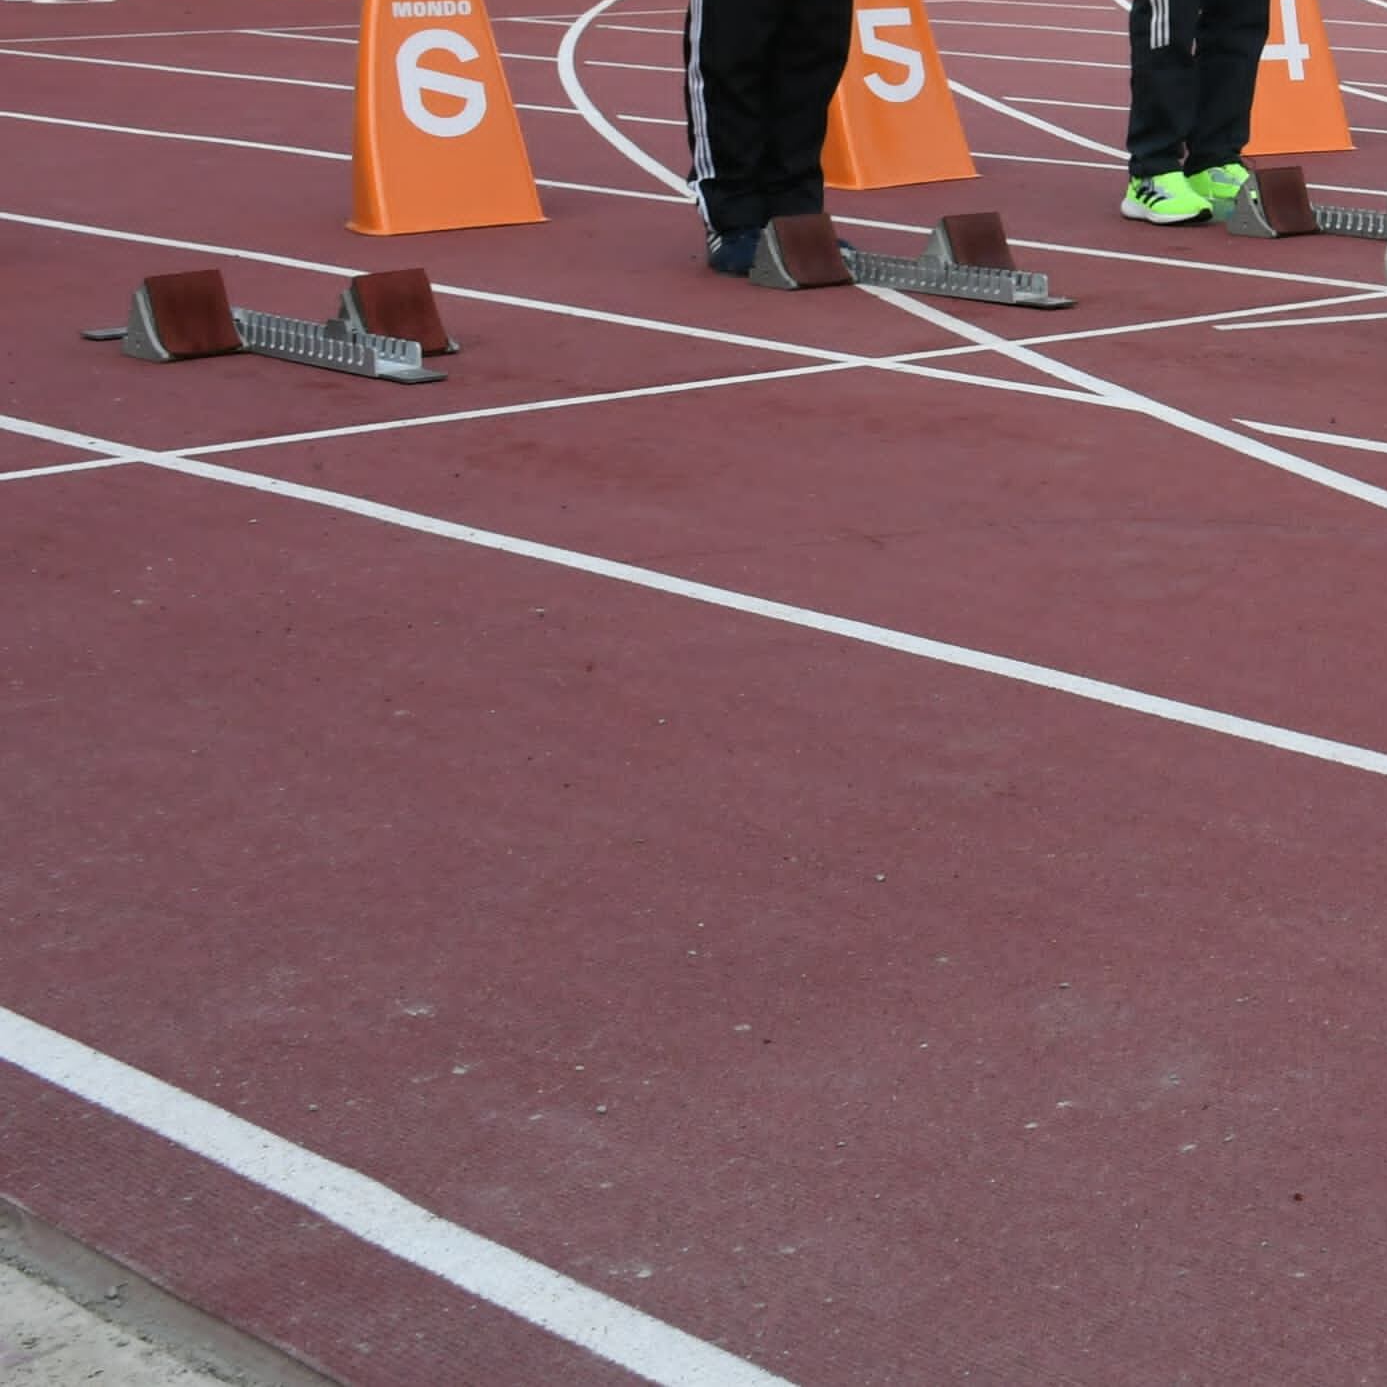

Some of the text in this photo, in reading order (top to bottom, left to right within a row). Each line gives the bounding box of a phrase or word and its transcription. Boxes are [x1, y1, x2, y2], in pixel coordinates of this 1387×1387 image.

[391, 0, 472, 18] MONDO
[855, 7, 926, 103] 5
[395, 28, 487, 138] 6
